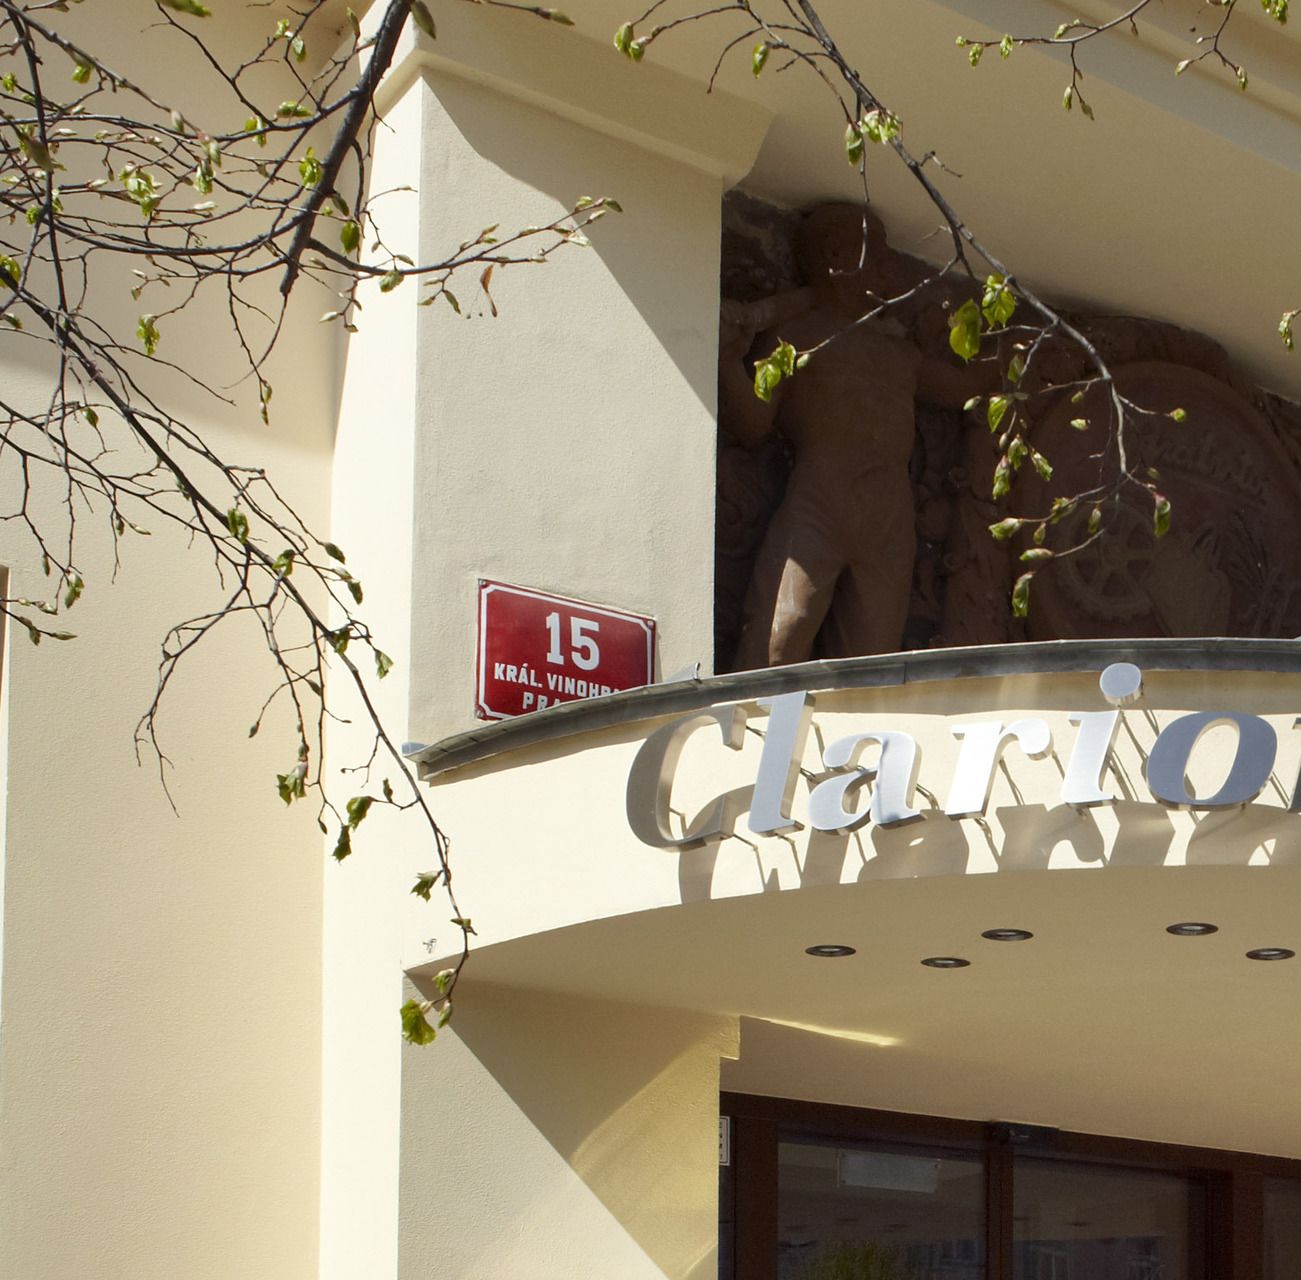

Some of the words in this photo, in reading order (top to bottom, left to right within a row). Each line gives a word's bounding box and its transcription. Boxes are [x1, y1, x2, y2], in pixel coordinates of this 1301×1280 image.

[546, 612, 600, 670] 15
[494, 662, 543, 688] KRÁL.
[547, 673, 621, 699] VINOHR
